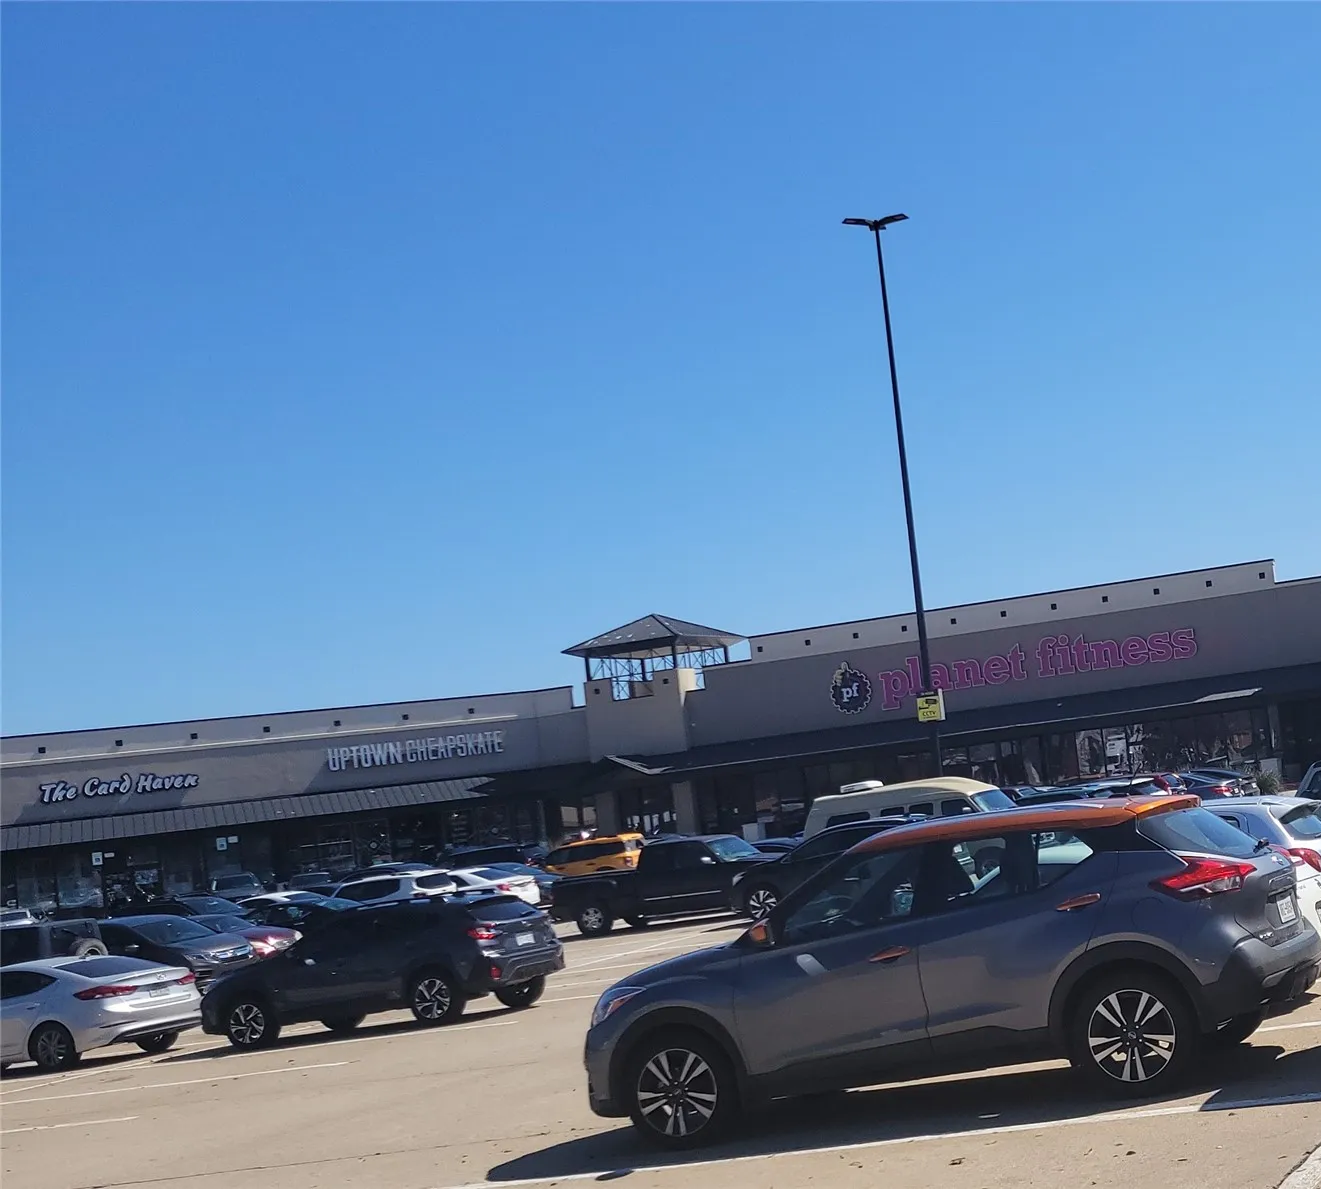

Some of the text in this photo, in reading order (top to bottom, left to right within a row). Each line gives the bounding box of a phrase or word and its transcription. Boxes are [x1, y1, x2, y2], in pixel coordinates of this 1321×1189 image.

[879, 628, 1198, 711] planet fitness
[841, 681, 860, 700] pf
[327, 731, 504, 771] UPTOWN CHEAPSKATE
[40, 773, 199, 803] The Card Haven
